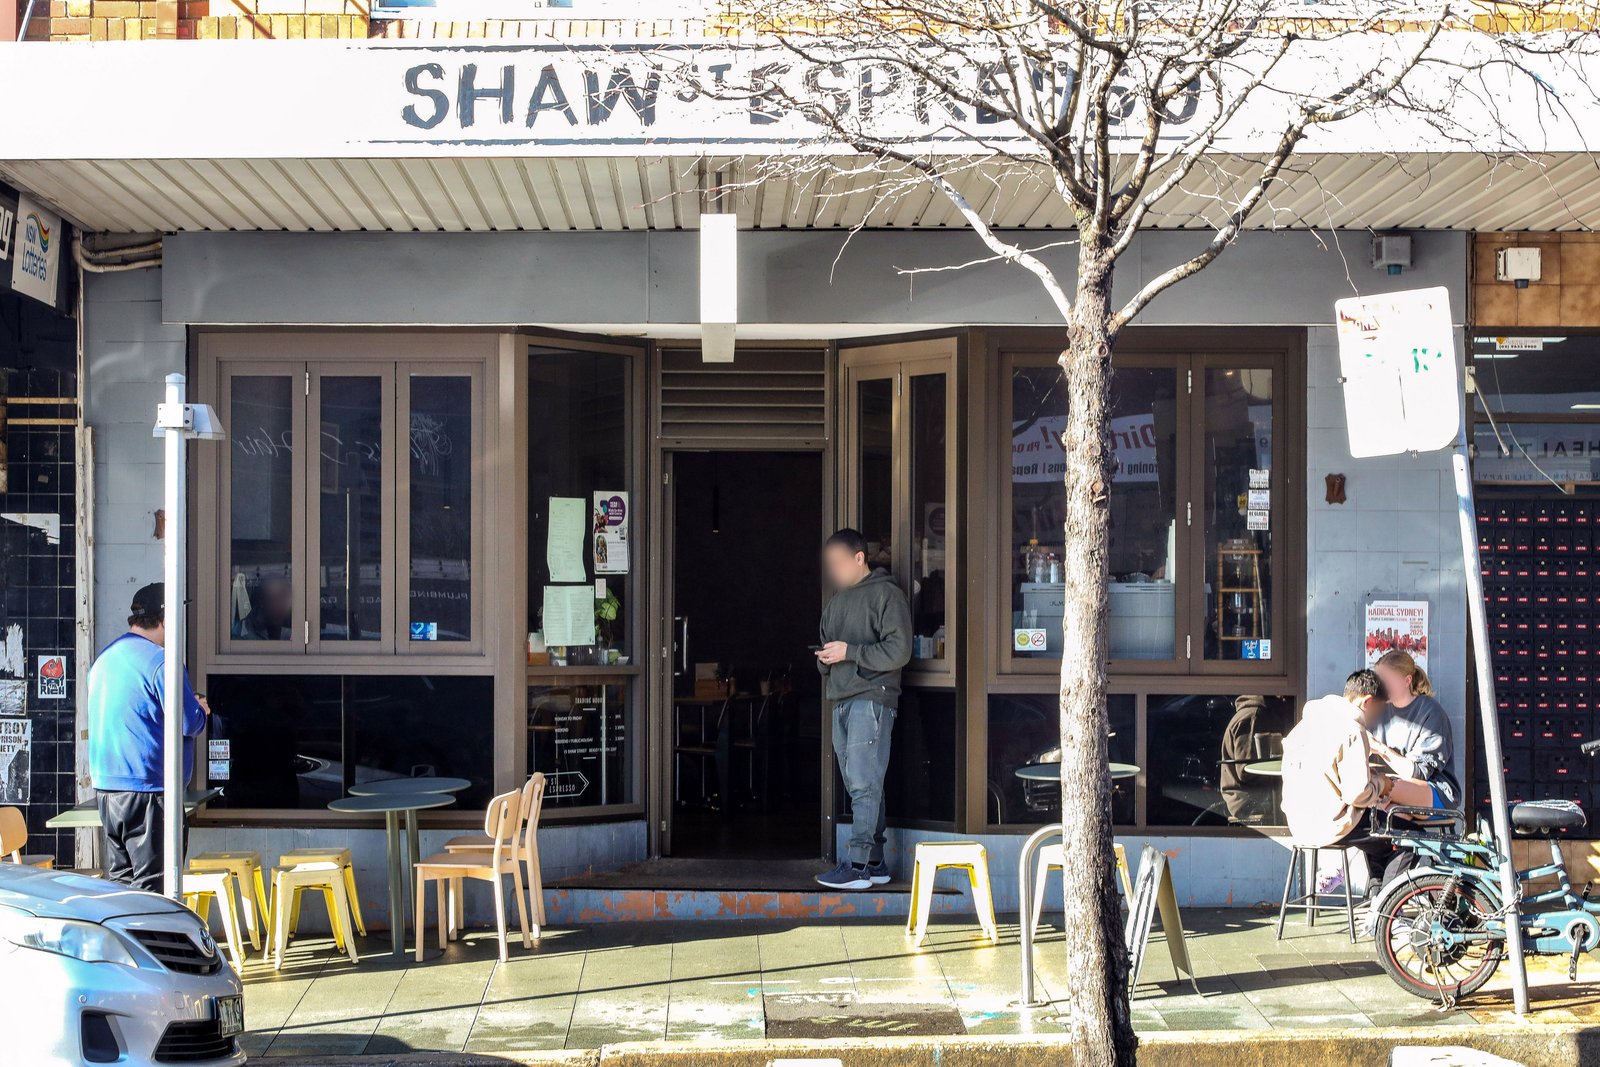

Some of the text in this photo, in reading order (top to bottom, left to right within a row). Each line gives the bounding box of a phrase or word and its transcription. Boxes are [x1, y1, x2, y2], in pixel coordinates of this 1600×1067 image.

[401, 62, 661, 129] SHAW
[22, 242, 48, 281] Lotteries
[1368, 608, 1424, 617] RADICAL SYDNEY!
[40, 687, 65, 696] RICH
